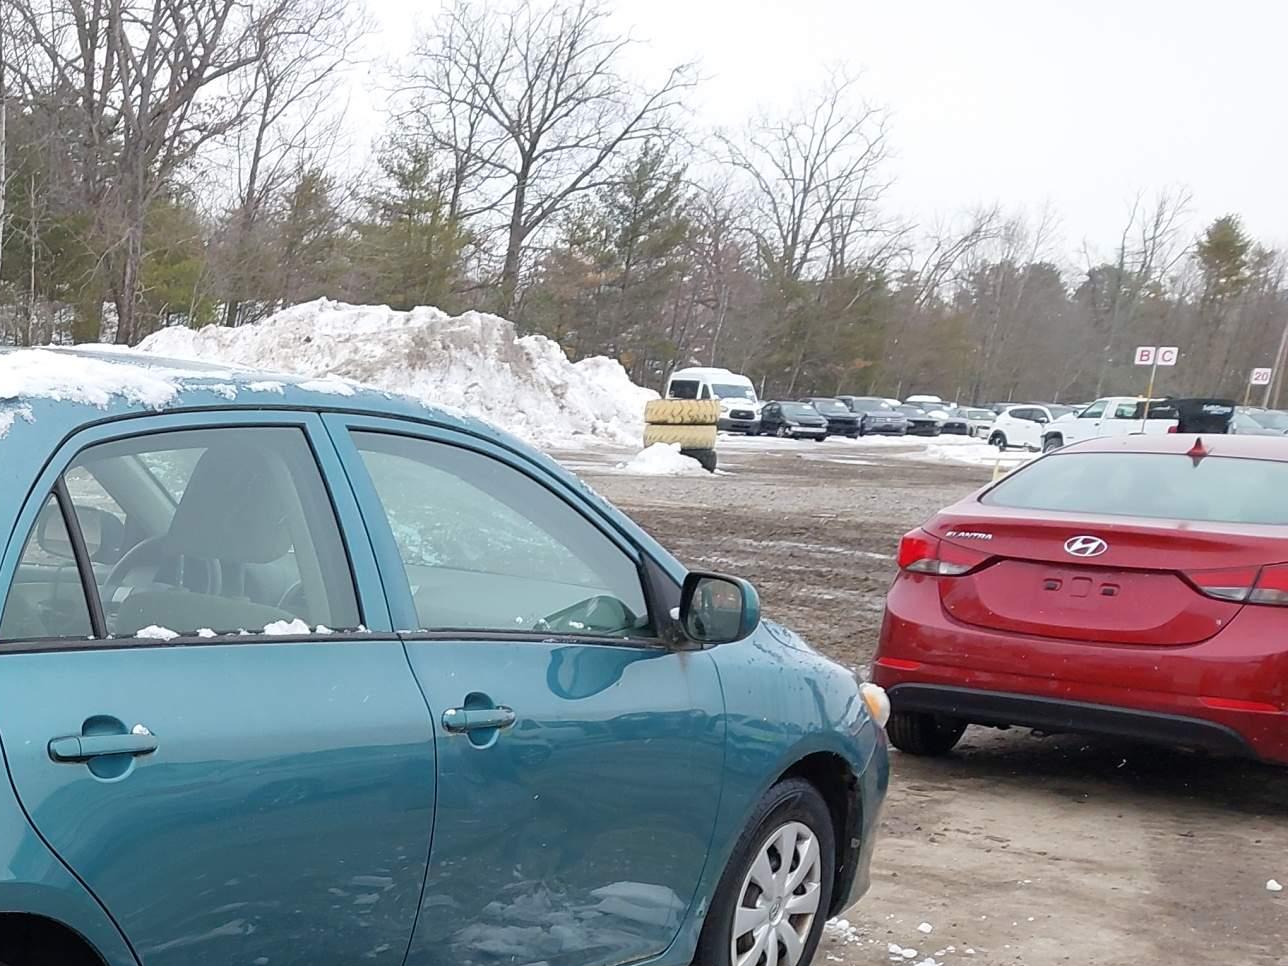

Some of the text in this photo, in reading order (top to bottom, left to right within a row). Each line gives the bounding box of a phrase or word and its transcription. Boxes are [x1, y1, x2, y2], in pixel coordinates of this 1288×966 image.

[1140, 350, 1150, 361] B
[1162, 350, 1173, 362] C
[945, 531, 992, 540] ELANTRA
